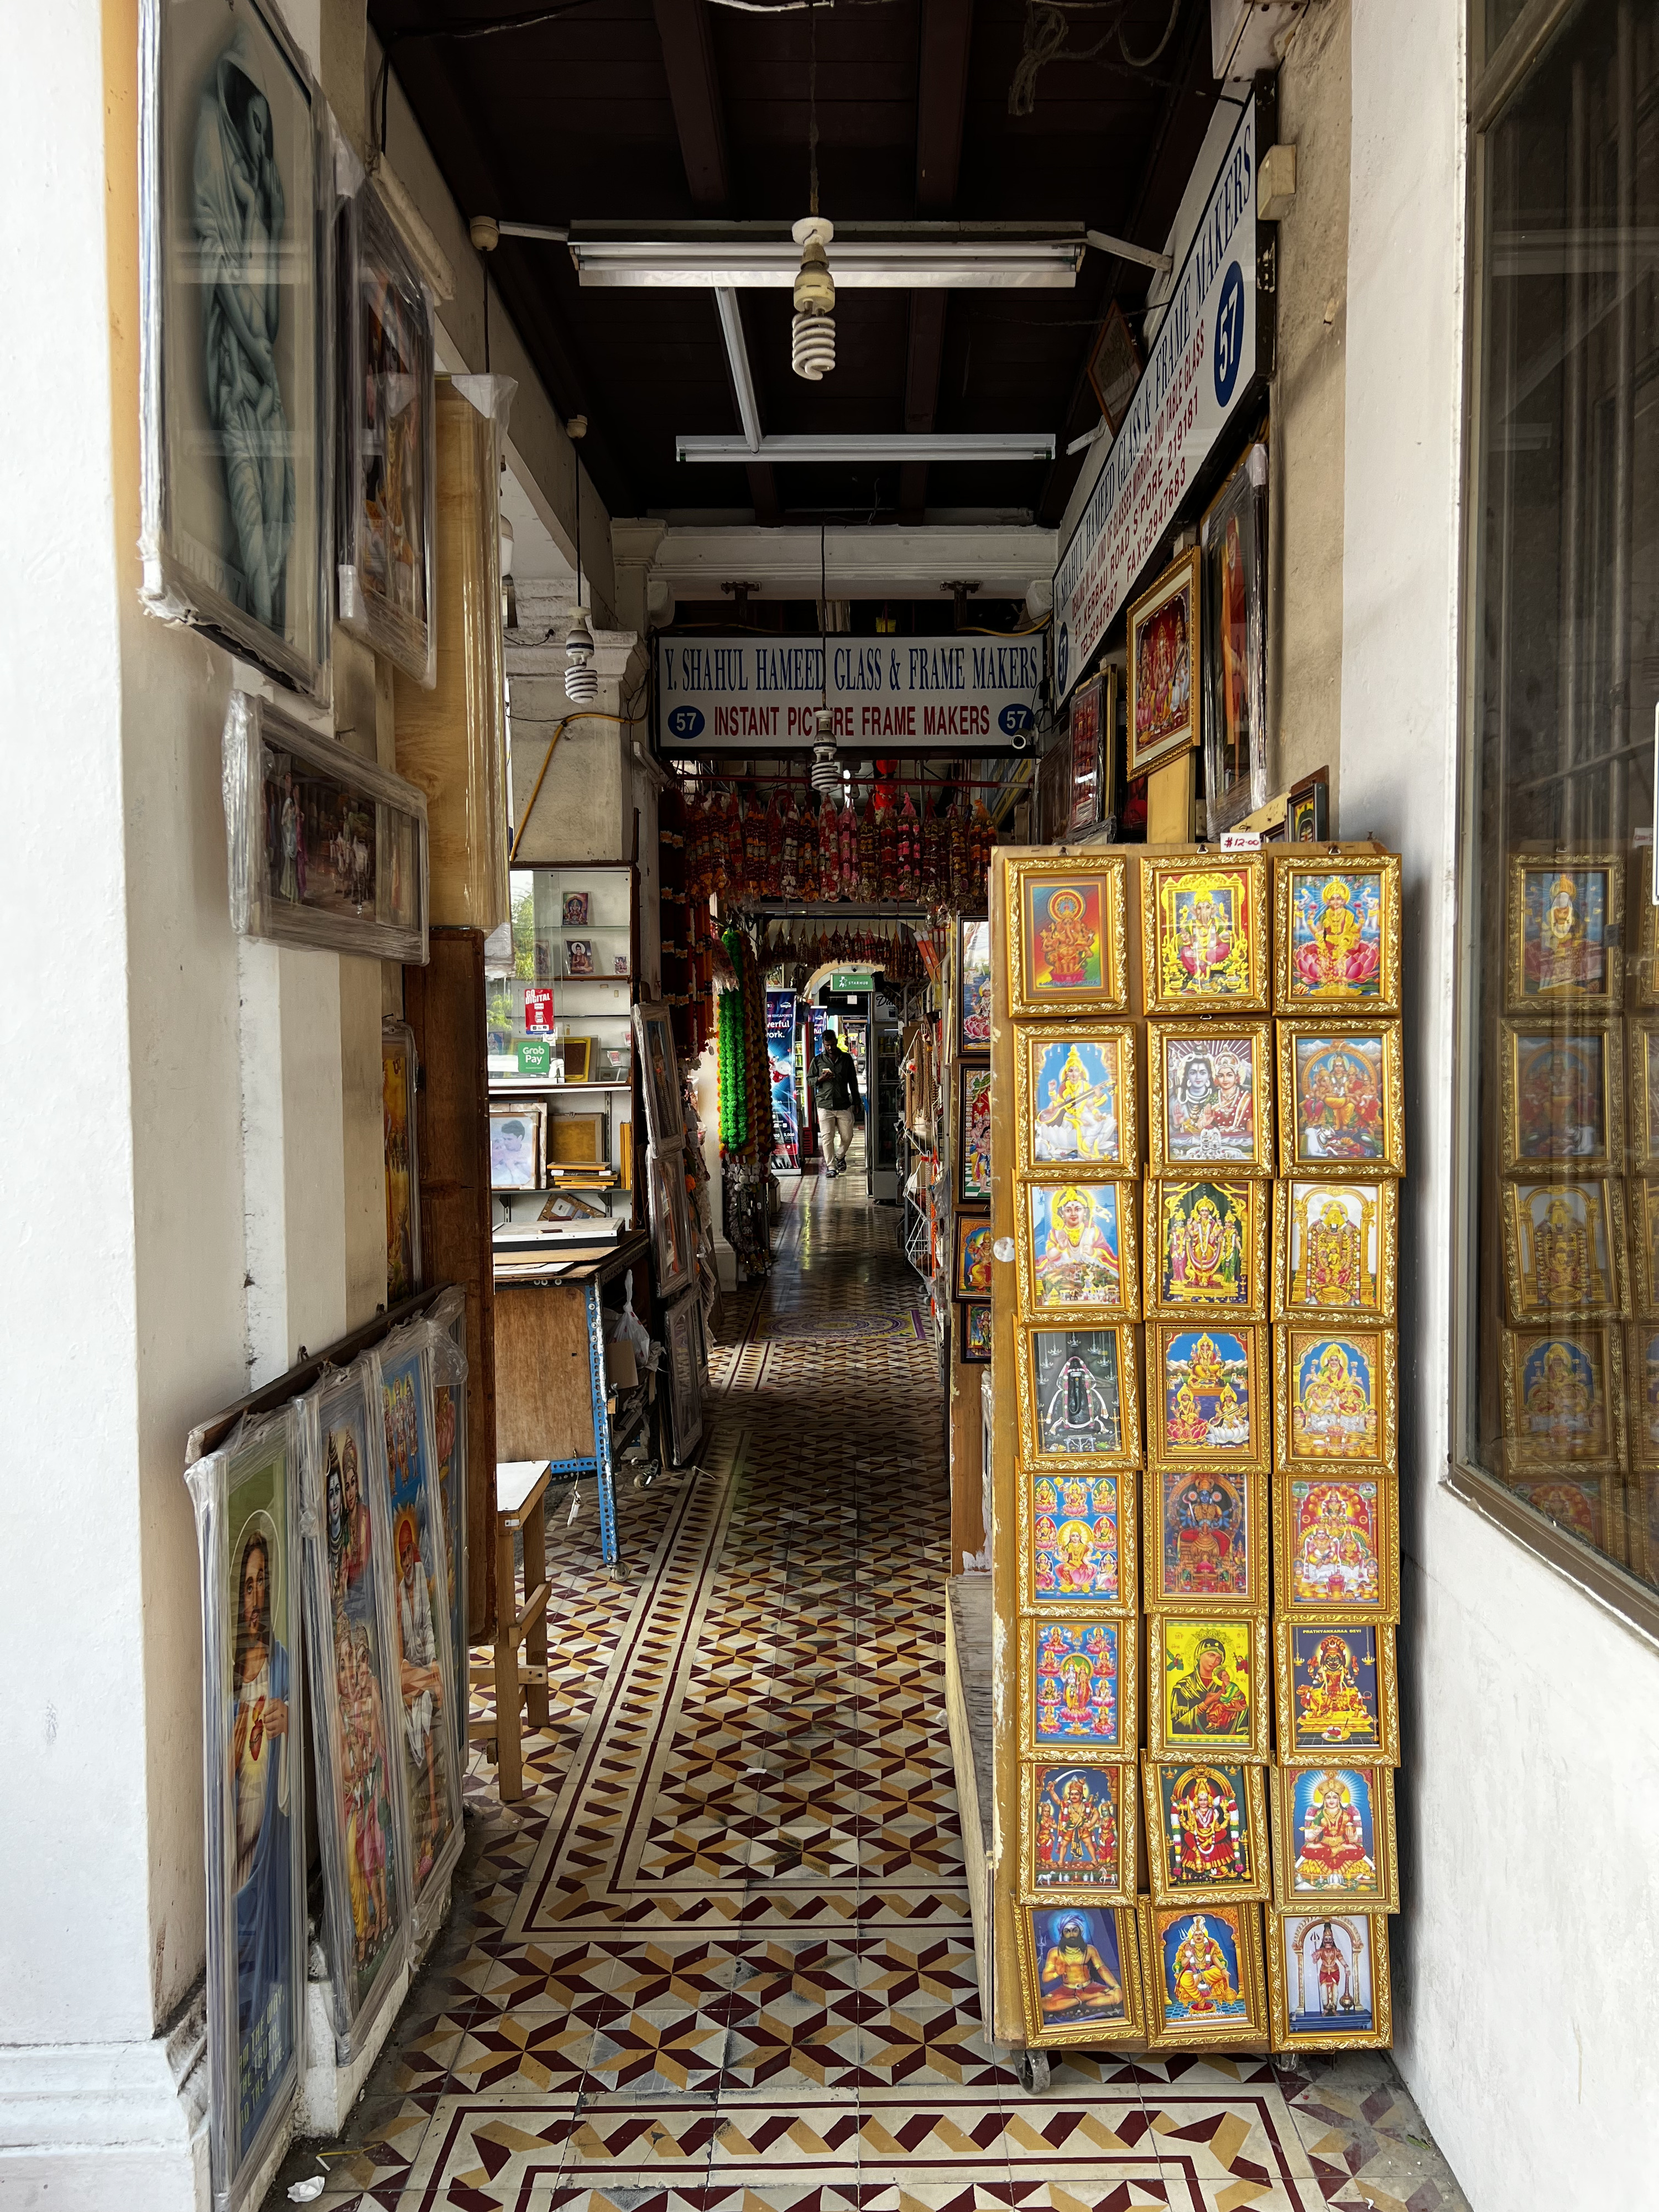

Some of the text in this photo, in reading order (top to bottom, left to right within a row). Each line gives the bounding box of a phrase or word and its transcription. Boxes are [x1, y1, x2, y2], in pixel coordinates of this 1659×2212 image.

[1219, 281, 1238, 383] 57
[1061, 527, 1083, 611] SHAHUL
[1086, 461, 1114, 562] HAMEED
[1118, 397, 1141, 492] GLASS
[1145, 379, 1151, 435] &
[1155, 273, 1191, 413] FRAME
[1195, 123, 1251, 319] MAKERS
[1107, 519, 1112, 553] OF
[1113, 479, 1131, 540] GLASSES
[1133, 435, 1152, 502] MIRRORS
[1154, 410, 1164, 459] AND
[1166, 367, 1182, 431] TABLE
[1185, 319, 1204, 392] GLASS
[1084, 566, 1108, 628] KERBAU
[1110, 525, 1130, 580] ROAD
[1134, 457, 1163, 536] S'PORE
[1167, 385, 1198, 472] 219181
[1127, 456, 1186, 583] FAX:62947683
[665, 646, 1037, 691] Y. SHAHUL HAMEED GLASS & FRAME MAKERS
[676, 712, 697, 732] 57
[714, 706, 780, 737] INSTANT
[862, 706, 916, 736] FRAME
[924, 705, 990, 735] MAKERS
[1006, 710, 1027, 729] 57
[525, 989, 535, 998] GO
[525, 993, 551, 1004] DIGITAL
[522, 1046, 545, 1055] Grab
[525, 1055, 542, 1065] Pay
[252, 2015, 264, 2052] THE
[251, 2071, 265, 2110] THE
